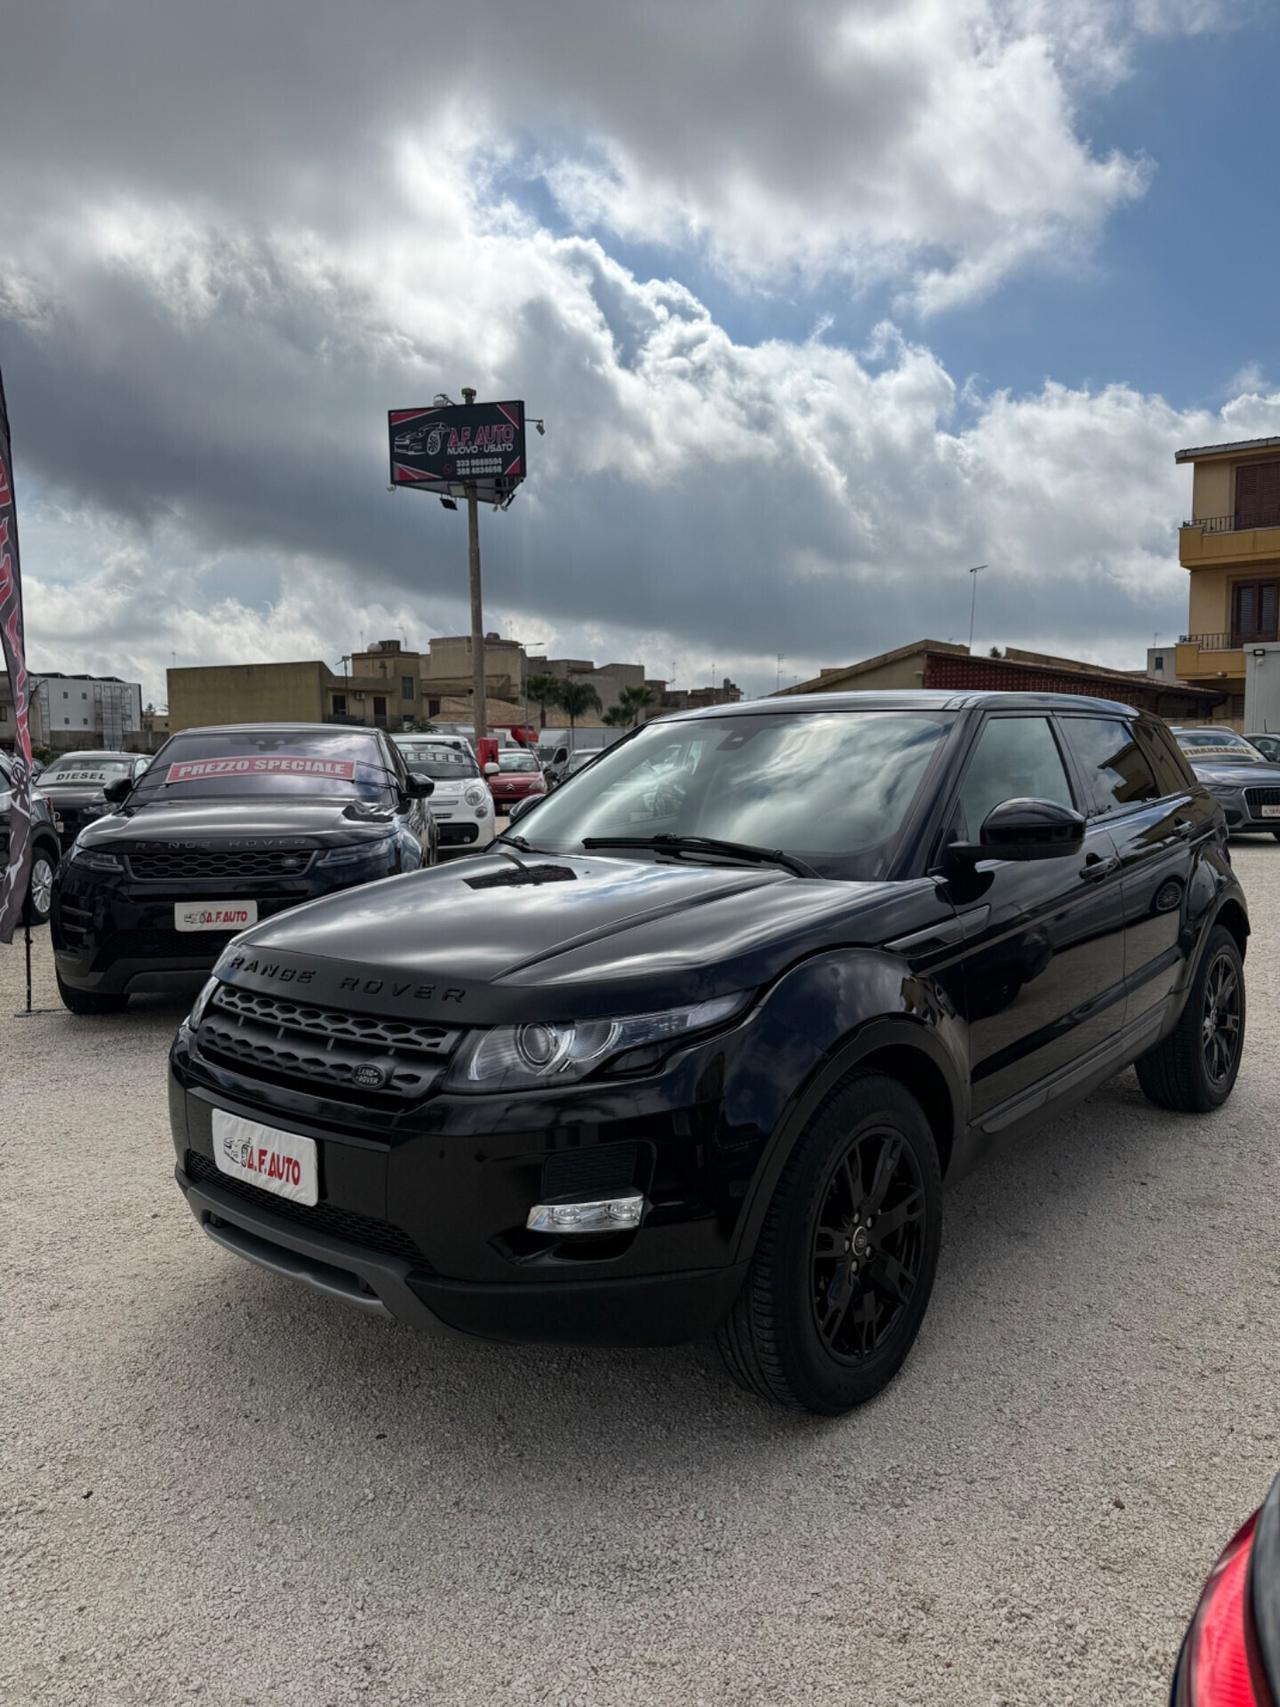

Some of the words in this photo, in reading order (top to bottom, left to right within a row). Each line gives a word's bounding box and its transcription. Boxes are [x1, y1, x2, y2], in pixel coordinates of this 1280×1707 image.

[474, 424, 514, 445] AUTO
[447, 445, 478, 455] NUOVO
[484, 443, 513, 453] USATO
[178, 760, 250, 777] PREZZO
[253, 759, 346, 775] SPECIALE
[56, 772, 106, 781] DIESEL
[136, 841, 212, 850] RANGE
[229, 839, 306, 848] ROVER
[229, 956, 316, 984] RANGE
[340, 976, 467, 1004] ROVER
